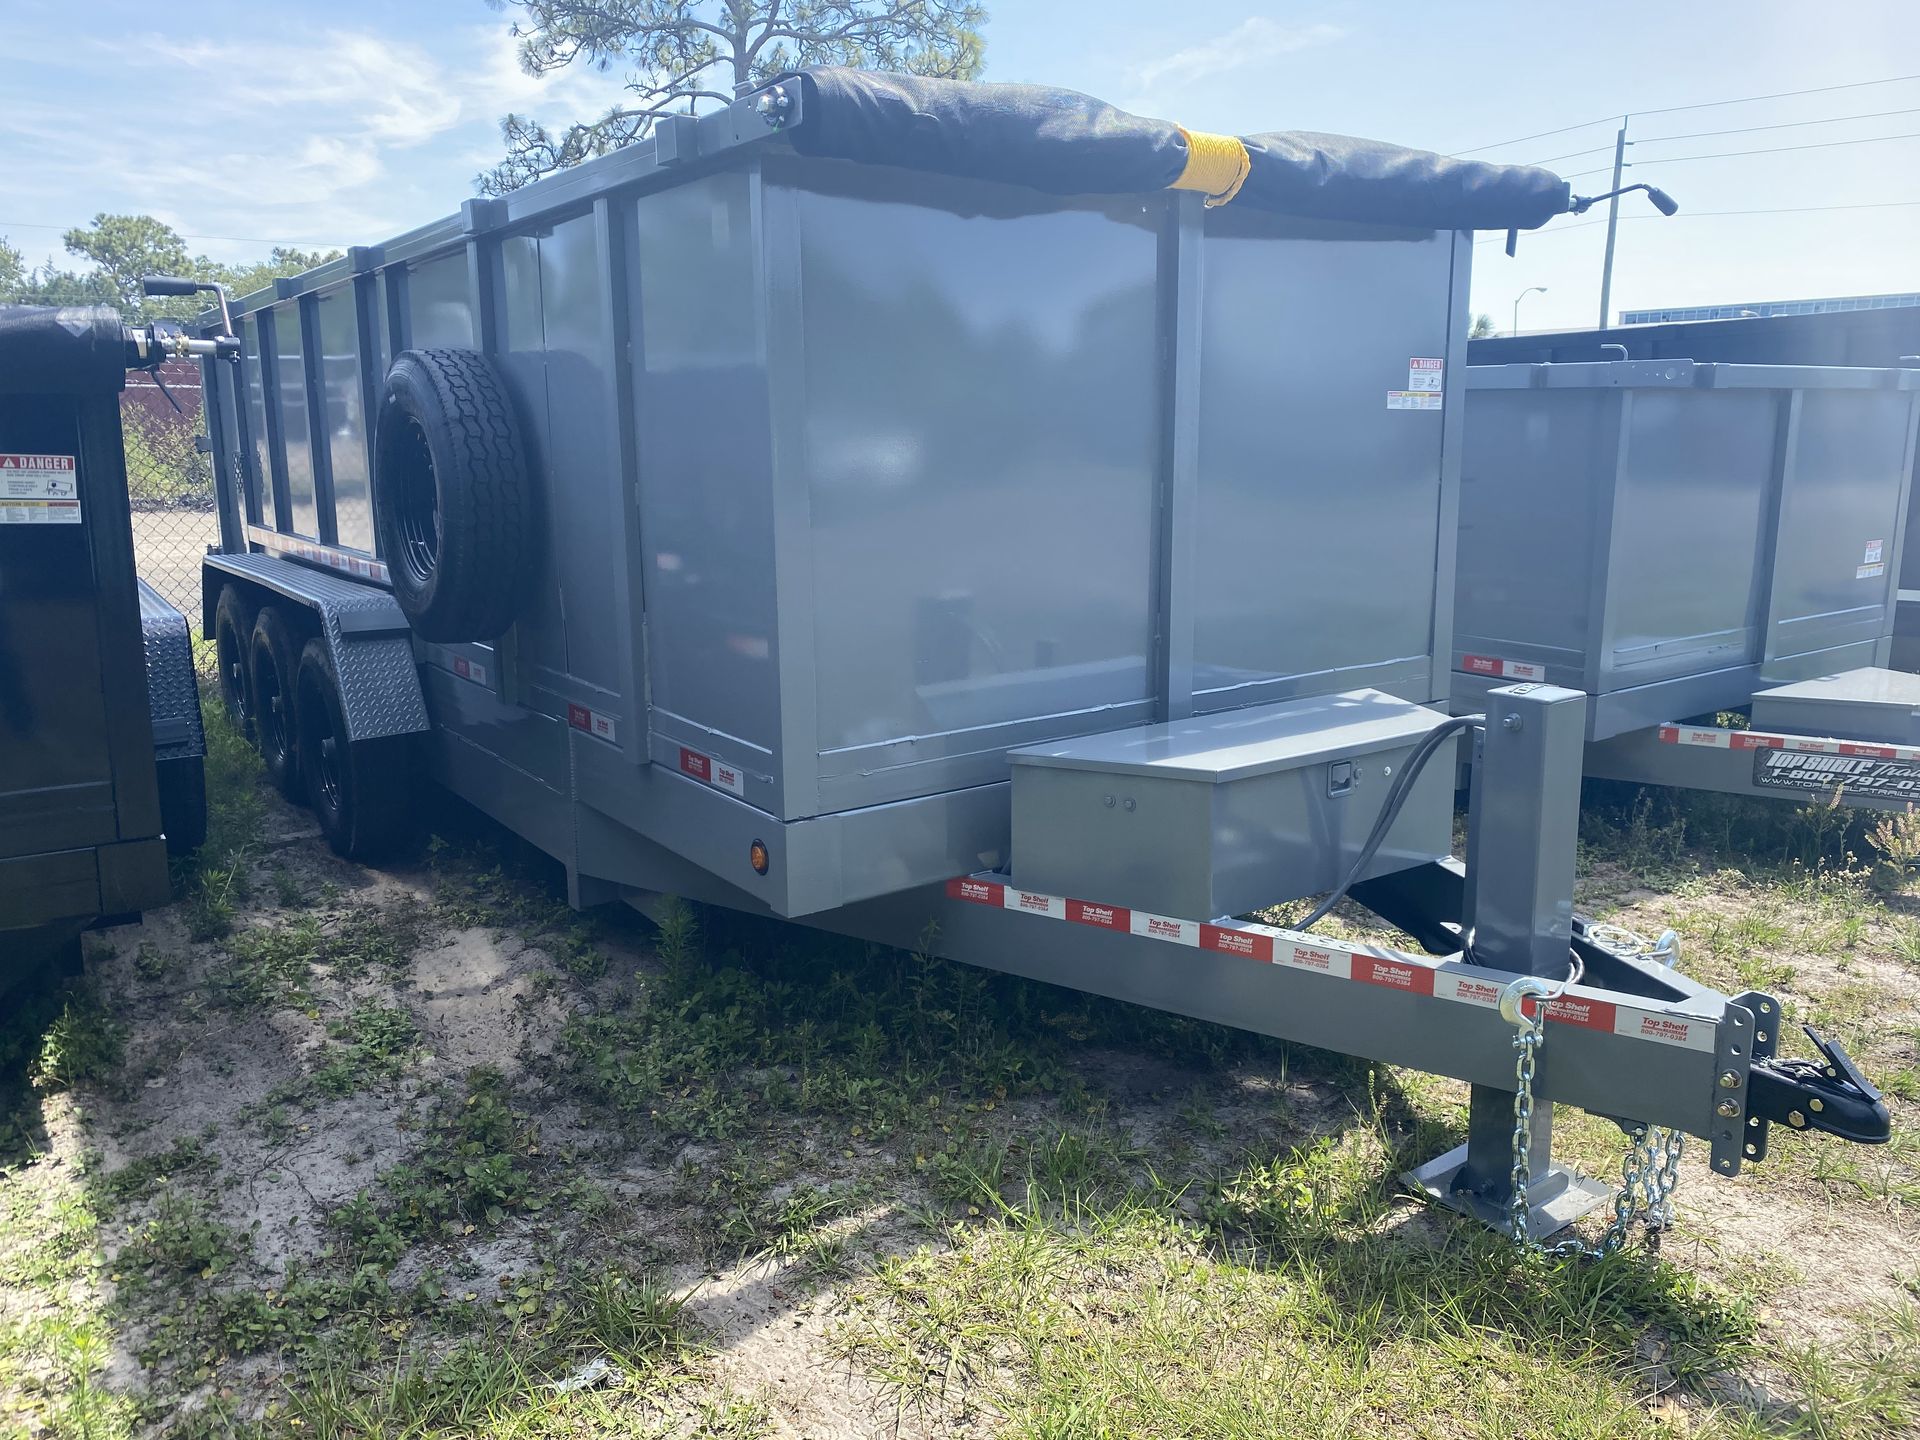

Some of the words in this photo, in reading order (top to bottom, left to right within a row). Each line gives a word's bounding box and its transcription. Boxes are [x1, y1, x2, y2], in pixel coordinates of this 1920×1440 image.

[20, 457, 69, 469] DANGER
[961, 882, 972, 891] Top
[973, 884, 989, 892] Shelf
[1020, 893, 1032, 902] Top
[1032, 895, 1049, 904] Shelf
[1082, 905, 1095, 914] Top
[1095, 907, 1113, 917] Shelf
[1149, 918, 1162, 927] Top
[1162, 920, 1181, 930] Shelf
[1219, 932, 1232, 942] Top
[1233, 935, 1253, 945] Shelf
[1294, 947, 1308, 958] Top
[1309, 950, 1330, 960] Shelf
[1373, 963, 1389, 975] Top
[1390, 967, 1412, 977] Shelf
[1372, 974, 1411, 986] 800-797-0384
[1457, 980, 1474, 992] Top
[1474, 983, 1498, 995] Shelf
[1456, 991, 1497, 1004] 800-797-0384
[1549, 998, 1563, 1010] op
[1565, 1001, 1591, 1013] Shelf
[1545, 1009, 1589, 1022] 800-797-0384
[1643, 1017, 1660, 1027] Top
[1662, 1020, 1689, 1032] Shelf
[1640, 1028, 1687, 1042] 800-797-0384
